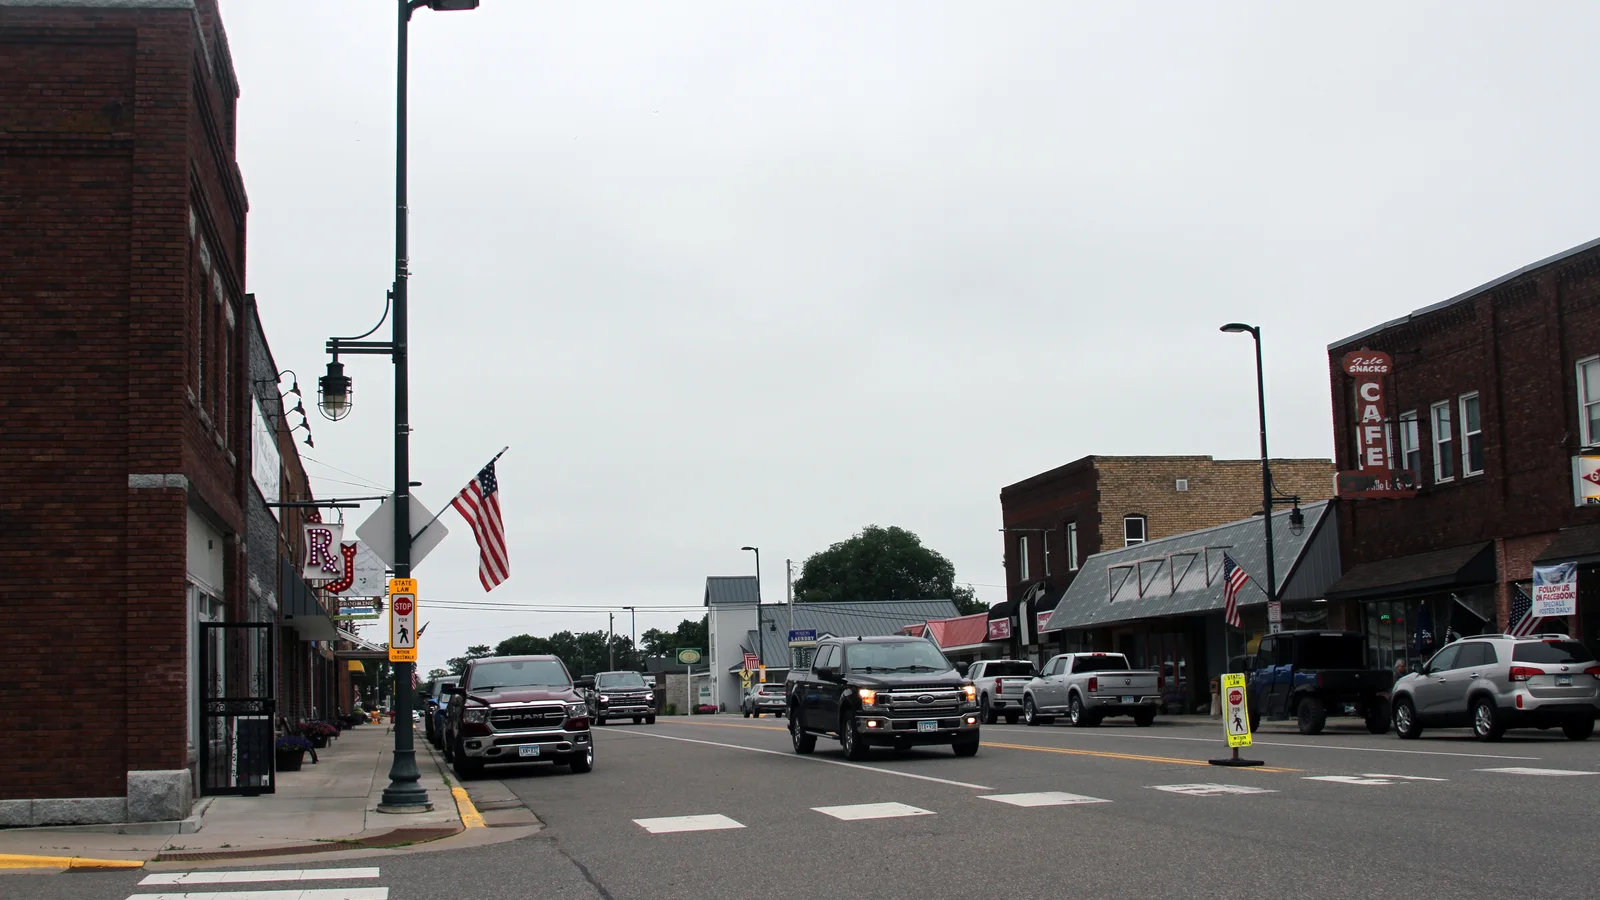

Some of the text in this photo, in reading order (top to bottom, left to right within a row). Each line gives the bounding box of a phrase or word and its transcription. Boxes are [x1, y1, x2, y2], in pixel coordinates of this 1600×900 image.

[1352, 357, 1384, 365] Isle
[1360, 383, 1384, 466] CAFE
[1538, 585, 1561, 593] FOLLOW
[394, 602, 412, 611] STOP
[1230, 694, 1242, 702] STOP
